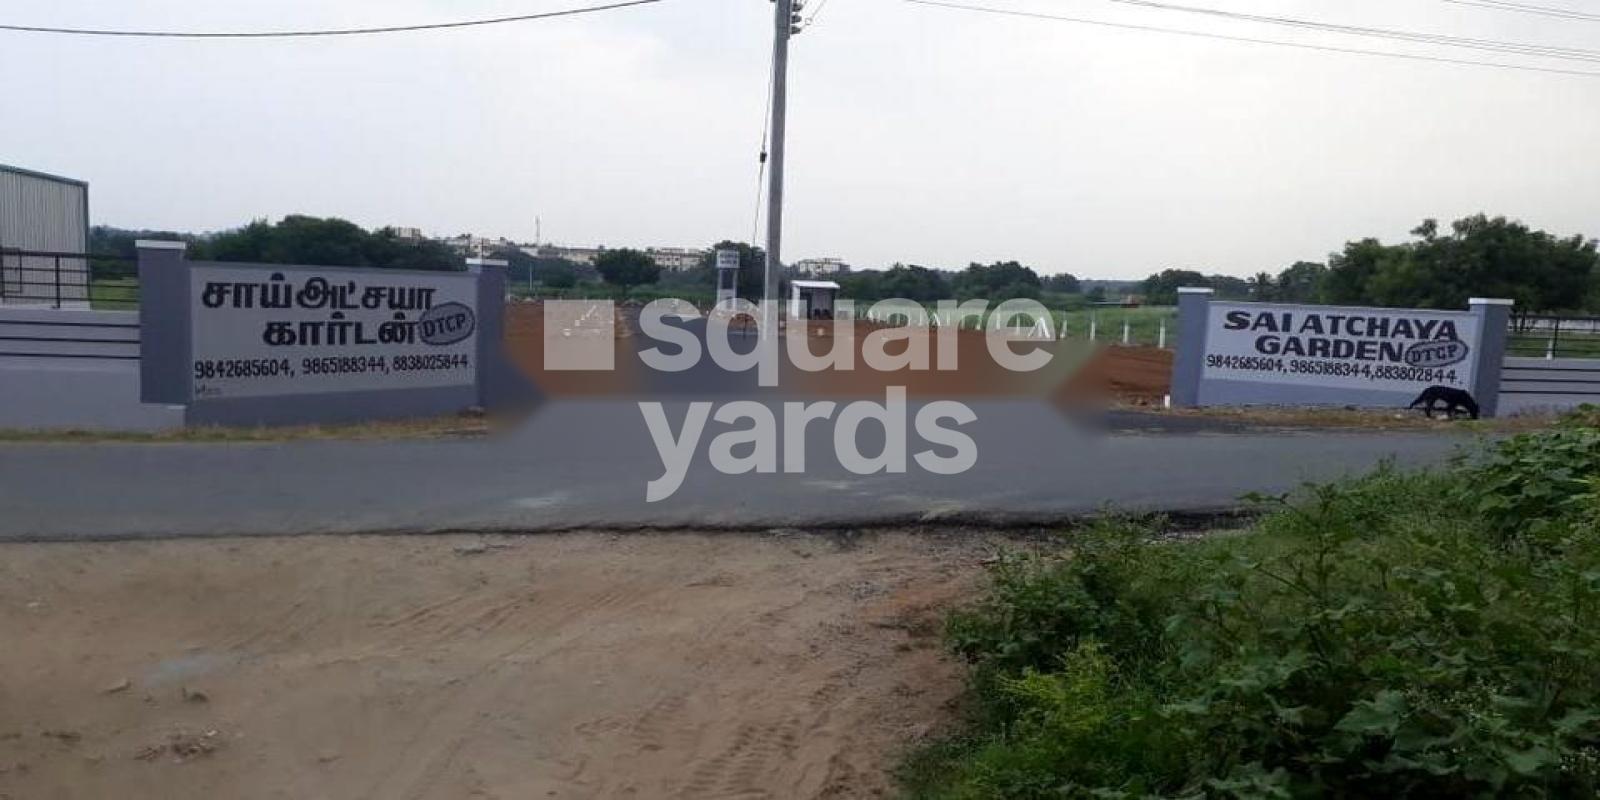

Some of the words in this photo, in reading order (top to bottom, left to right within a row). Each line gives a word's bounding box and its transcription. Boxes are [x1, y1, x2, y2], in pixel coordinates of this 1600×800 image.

[422, 313, 466, 338] DTCP
[1224, 311, 1293, 332] SAI
[1299, 313, 1458, 340] ATCHAYA
[1255, 335, 1403, 362] GARDEN
[1411, 344, 1458, 362] DTCP
